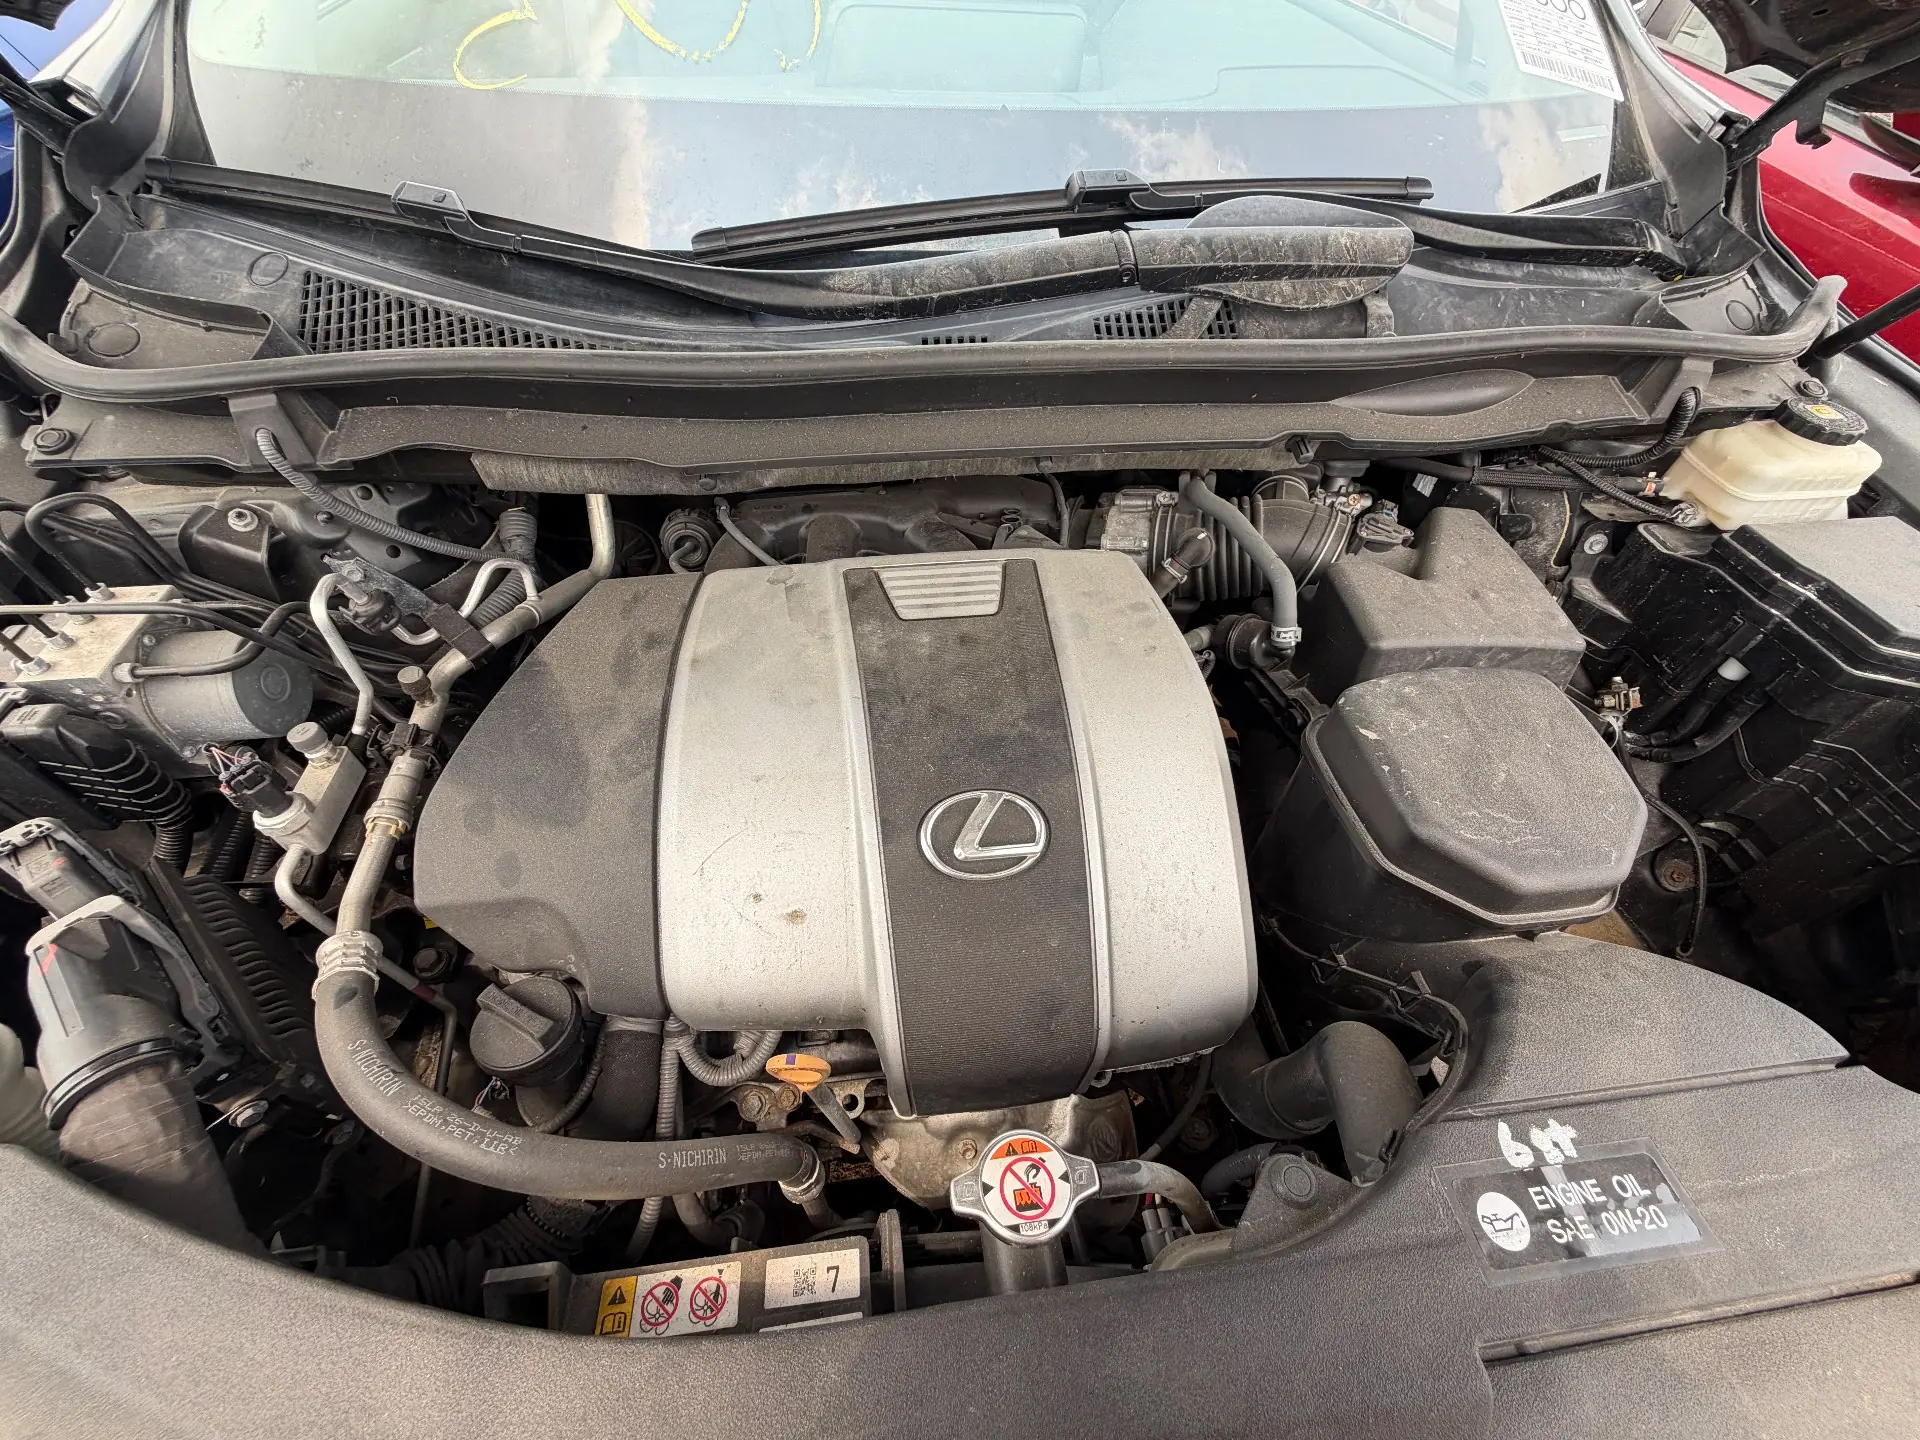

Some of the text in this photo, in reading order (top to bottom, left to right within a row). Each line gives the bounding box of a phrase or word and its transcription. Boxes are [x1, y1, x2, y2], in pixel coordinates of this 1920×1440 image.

[1527, 1172, 1652, 1211] ENGINE OIL
[1546, 1215, 1595, 1245] SAE
[826, 1265, 841, 1294] 7
